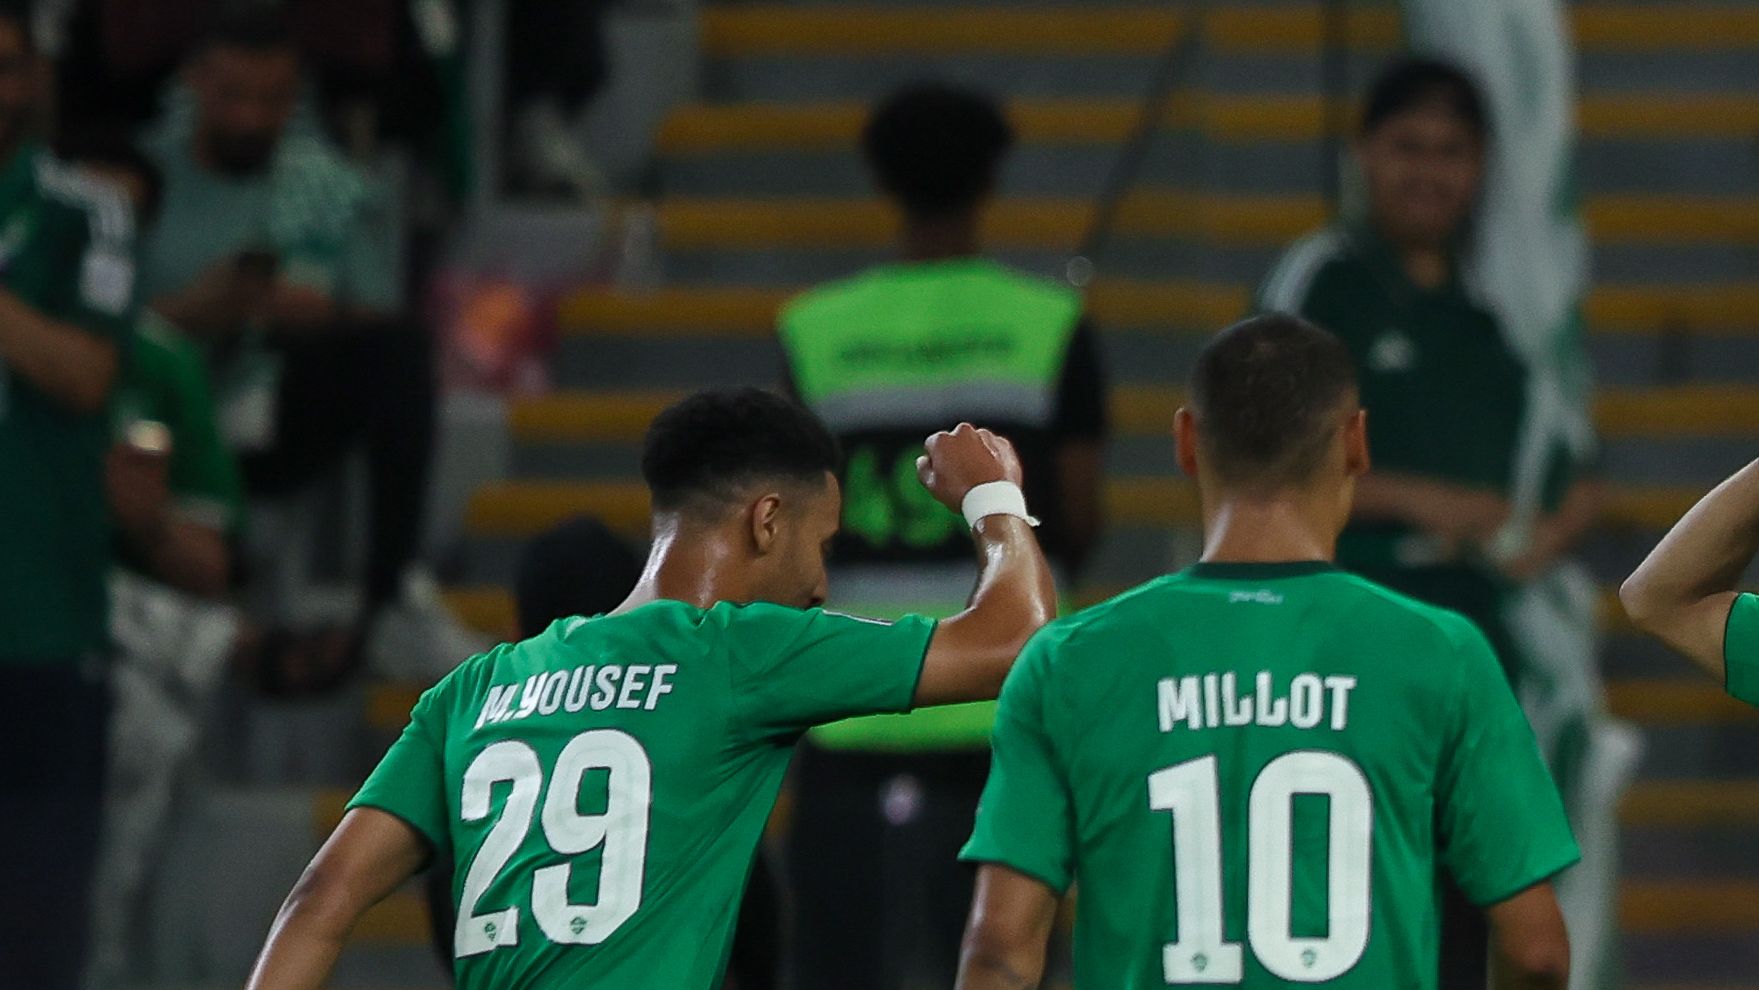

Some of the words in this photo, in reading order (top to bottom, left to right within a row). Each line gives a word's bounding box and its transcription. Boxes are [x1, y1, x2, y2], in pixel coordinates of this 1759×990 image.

[474, 664, 678, 730] M.YOUSEF
[1157, 669, 1358, 732] MILLOT
[455, 729, 652, 958] 29
[1148, 750, 1373, 984] 10
